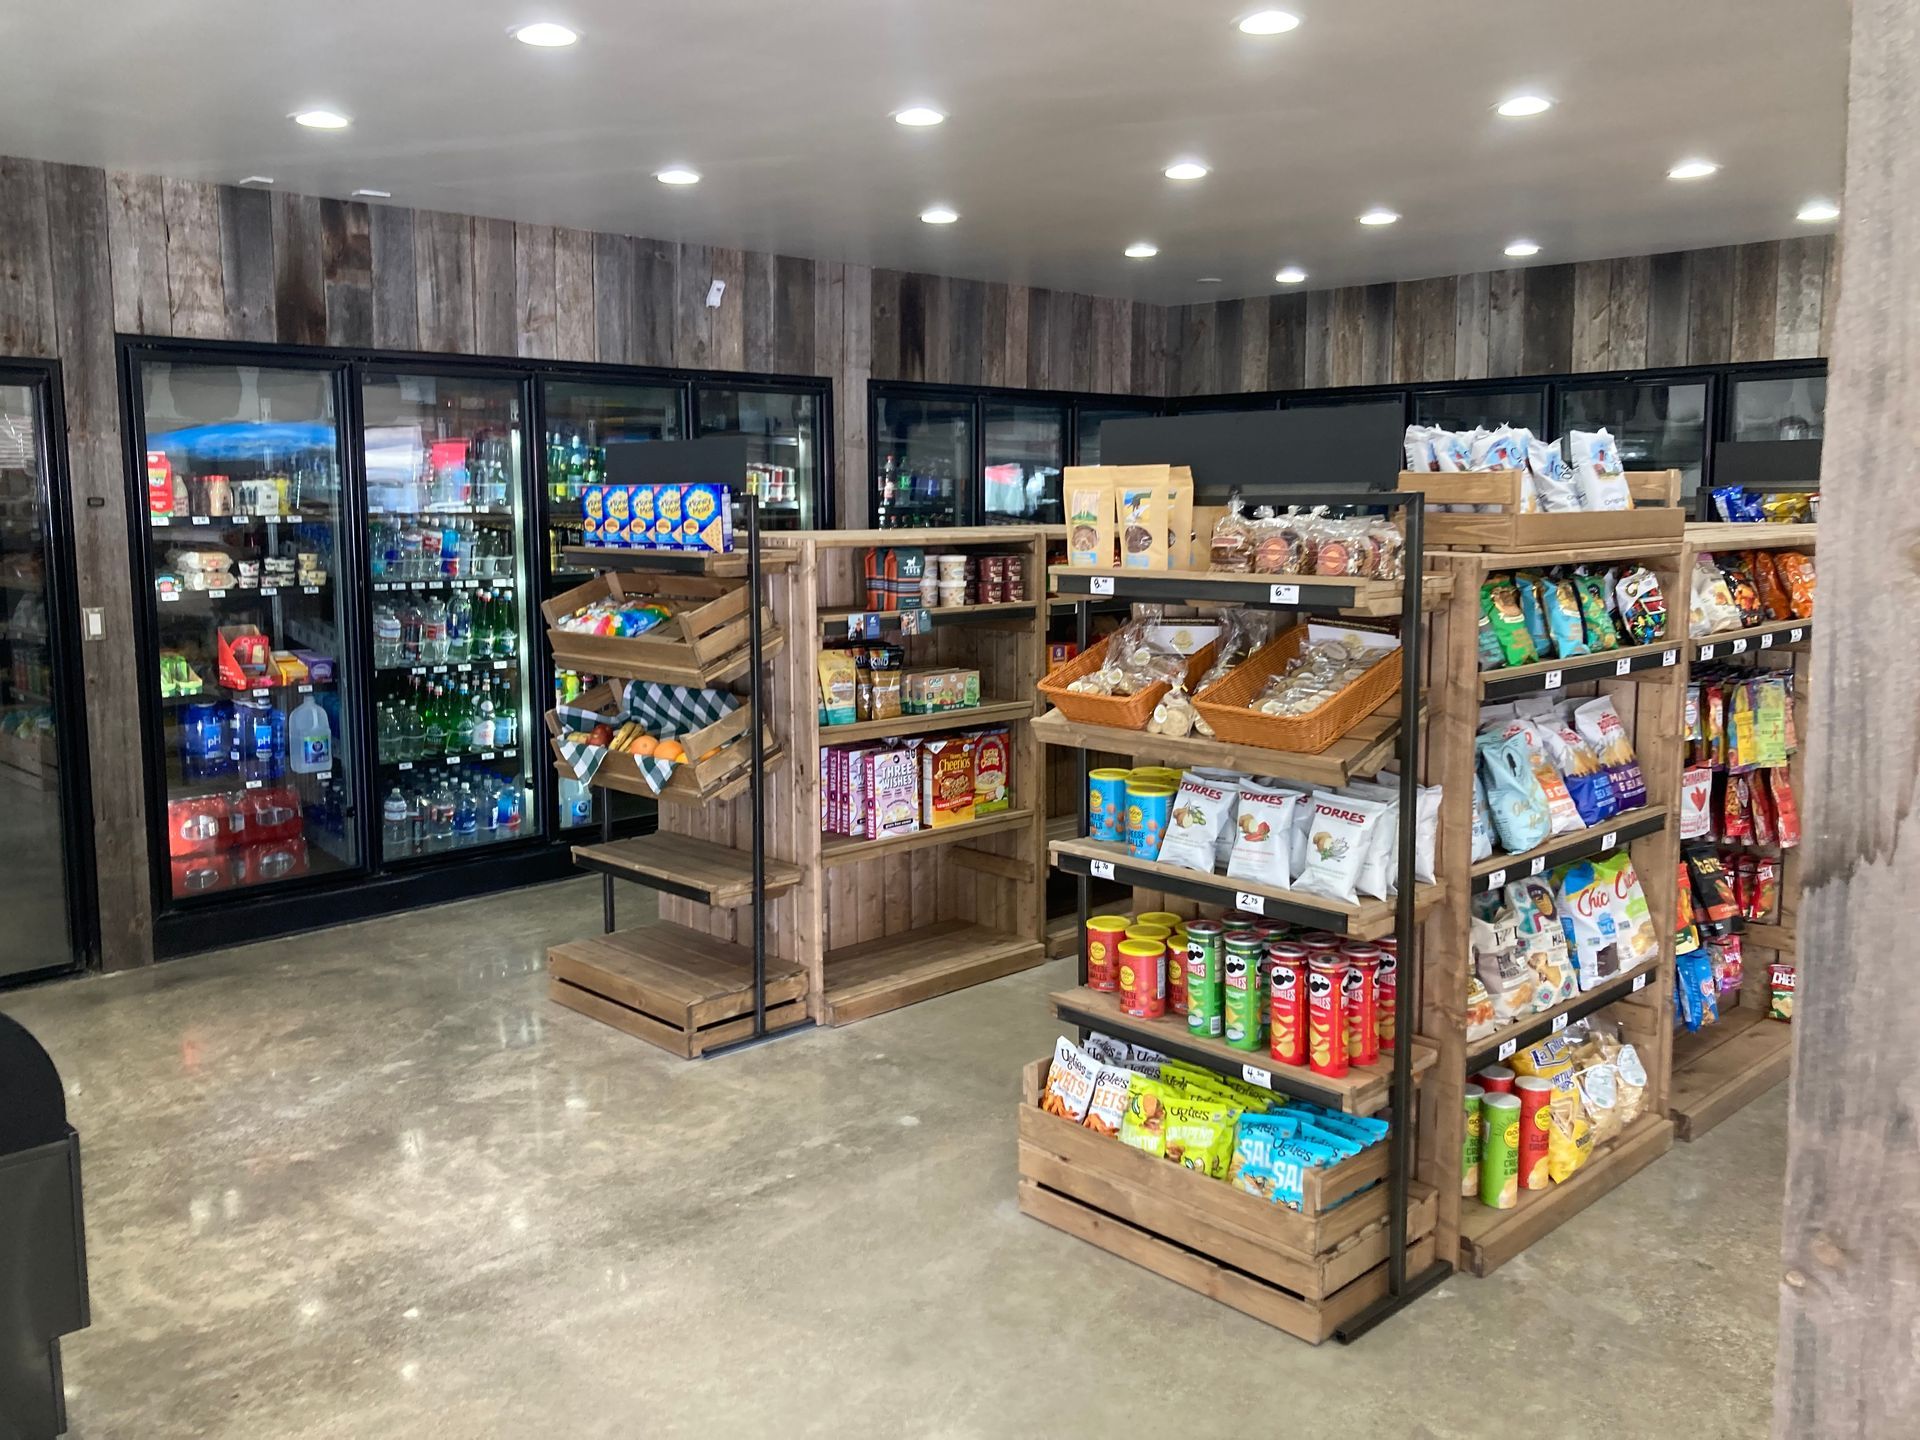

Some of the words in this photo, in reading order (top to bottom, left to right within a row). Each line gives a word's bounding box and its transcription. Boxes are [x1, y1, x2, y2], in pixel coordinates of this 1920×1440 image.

[870, 654, 889, 667] KIND
[208, 736, 221, 748] pH
[257, 736, 271, 747] pH
[882, 762, 913, 778] THREE
[939, 757, 970, 772] Cheerios
[866, 763, 874, 799] WISHES
[882, 775, 913, 790] WISHES
[1180, 781, 1223, 801] TORRES
[1239, 791, 1284, 806] TORRES
[867, 809, 875, 838] THREE
[1315, 804, 1366, 824] TORRES
[1578, 884, 1610, 917] Chic
[1061, 1048, 1087, 1077] Uglies
[1097, 1070, 1130, 1092] glies
[1094, 1087, 1128, 1112] EETS
[1170, 1106, 1210, 1122] Uglies
[1241, 1138, 1273, 1168] SAL
[1272, 1136, 1314, 1162] Uglies
